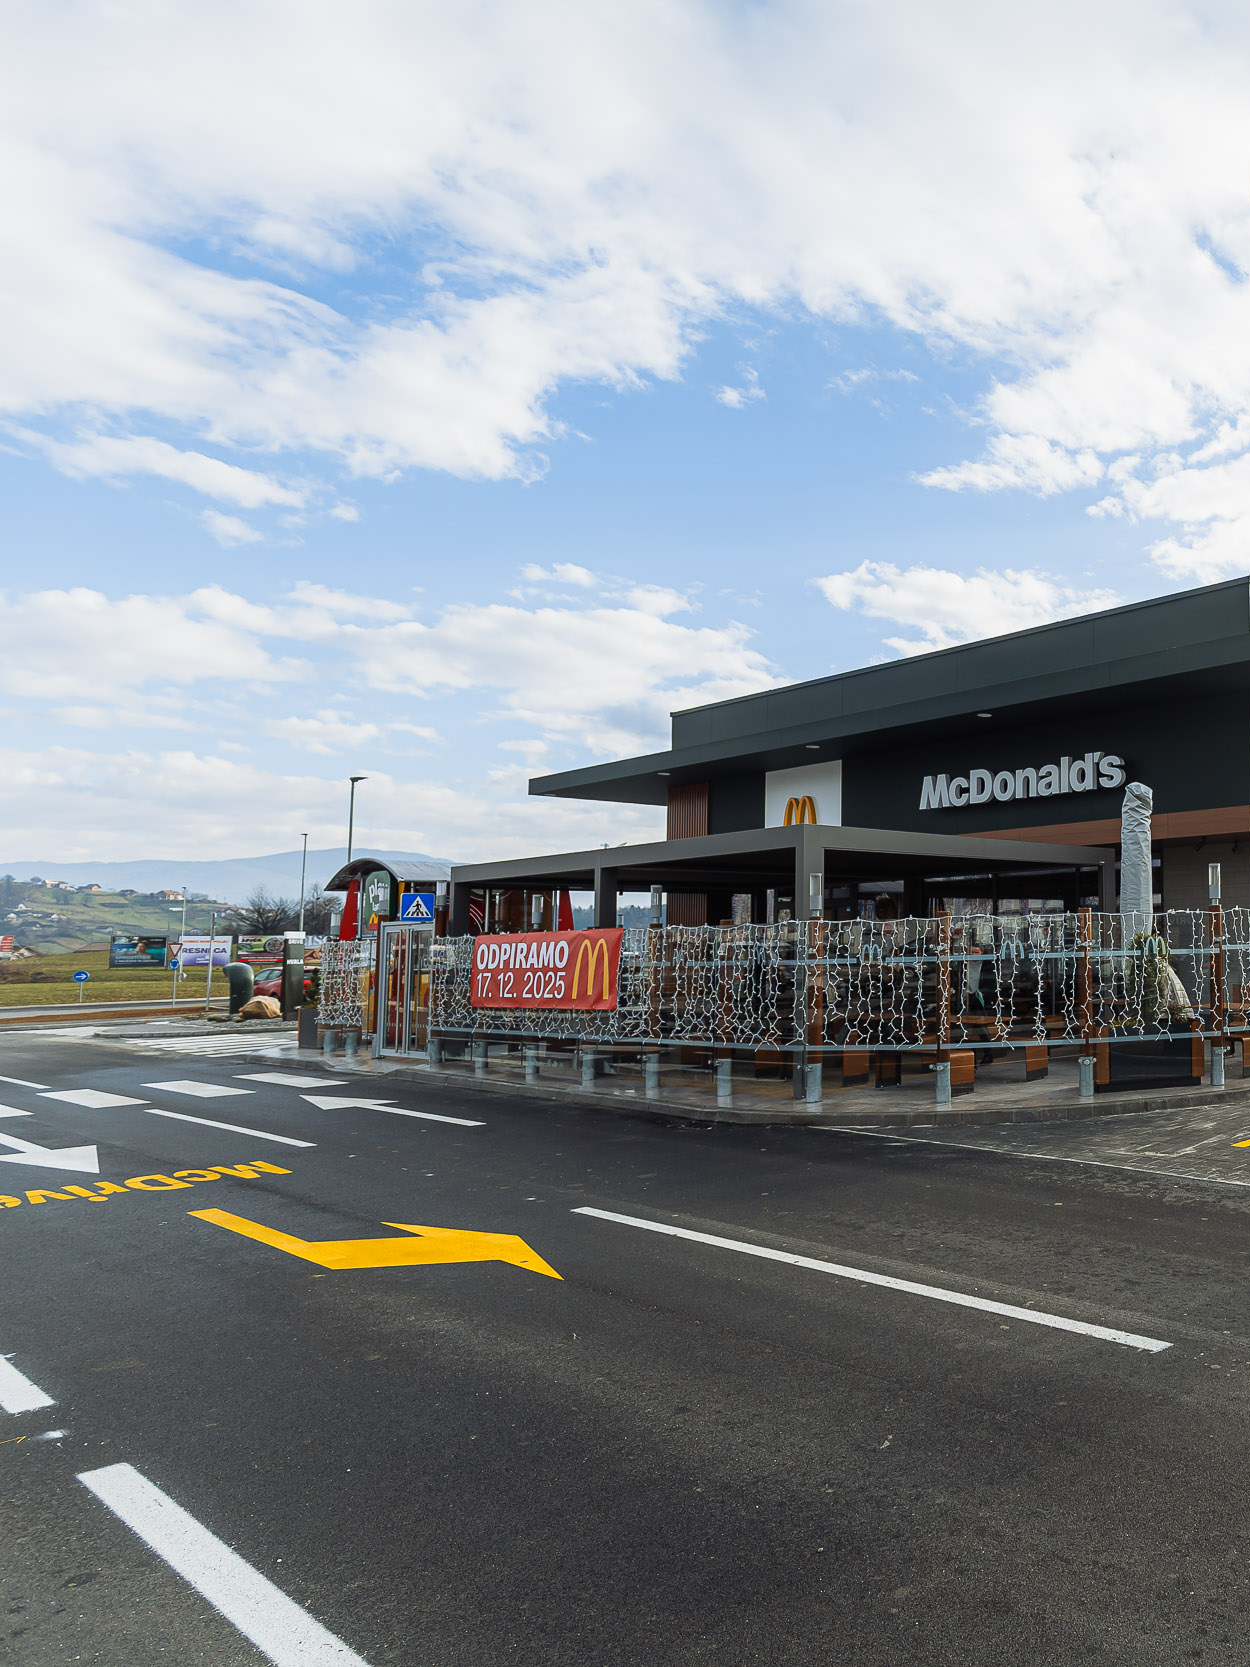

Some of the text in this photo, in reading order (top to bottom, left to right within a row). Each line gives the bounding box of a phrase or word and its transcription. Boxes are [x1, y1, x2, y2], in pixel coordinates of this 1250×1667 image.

[918, 751, 1126, 810] McDonald's
[476, 940, 569, 971] ODPIRAMO
[476, 971, 566, 999] 17. 12. 2025
